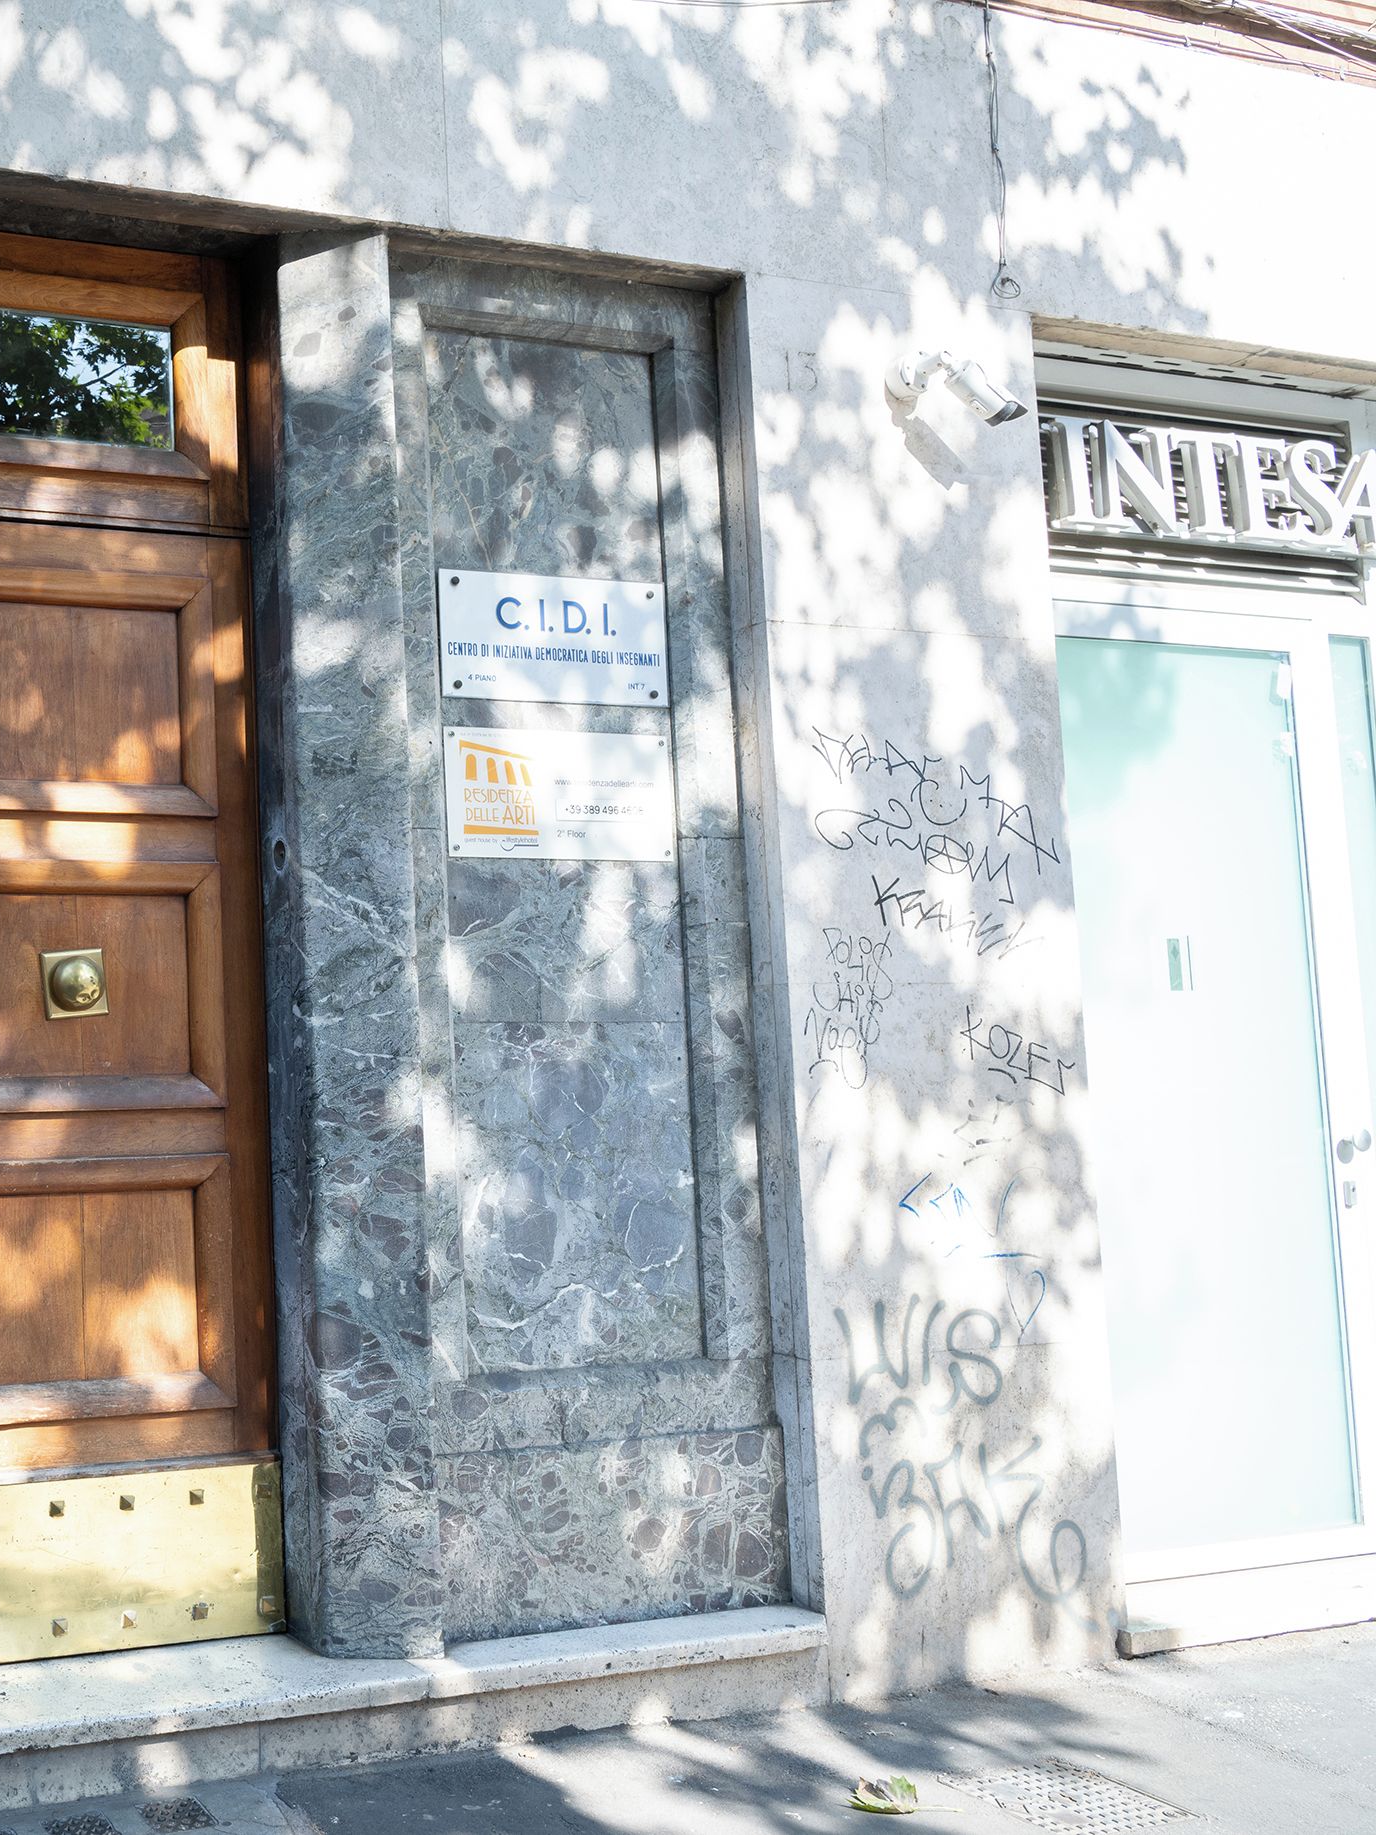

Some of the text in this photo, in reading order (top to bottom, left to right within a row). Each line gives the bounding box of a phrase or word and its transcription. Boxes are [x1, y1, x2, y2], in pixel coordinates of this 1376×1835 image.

[447, 641, 661, 667] CENTRO DI INIZIATIVA DEMOCRATICA DEGLI INSEGNANTI
[474, 674, 497, 682] PIANO
[463, 788, 535, 804] RESIDENZA
[465, 805, 536, 825] DELLE ARTI
[583, 804, 601, 815] 389
[567, 830, 587, 838] Floor
